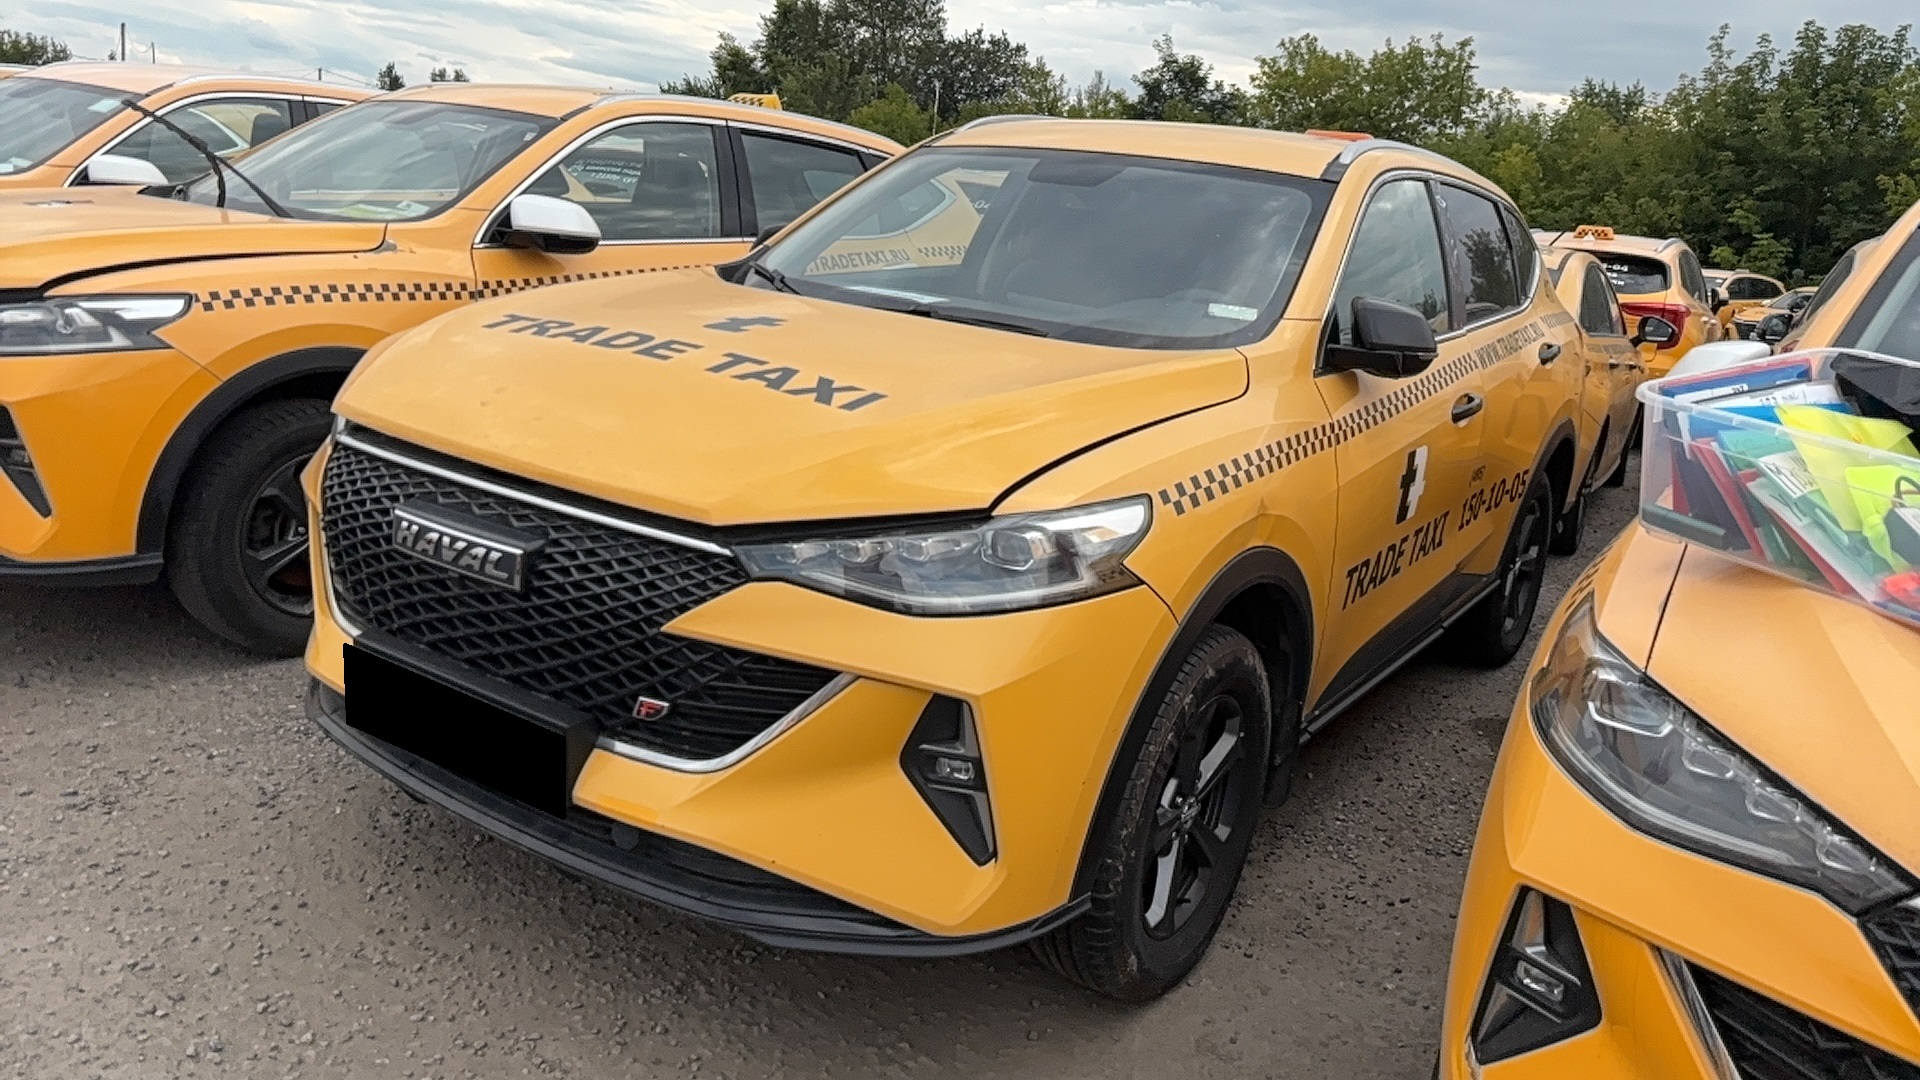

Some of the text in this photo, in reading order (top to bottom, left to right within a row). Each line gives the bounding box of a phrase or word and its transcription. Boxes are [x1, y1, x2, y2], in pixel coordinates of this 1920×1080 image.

[482, 313, 889, 412] TRADE TAXI
[1474, 320, 1546, 371] WWW.TRADETAXI.RU
[1457, 467, 1530, 532] 150-10-05
[395, 519, 510, 580] HAVAL
[1342, 511, 1450, 611] TRADE TAXI
